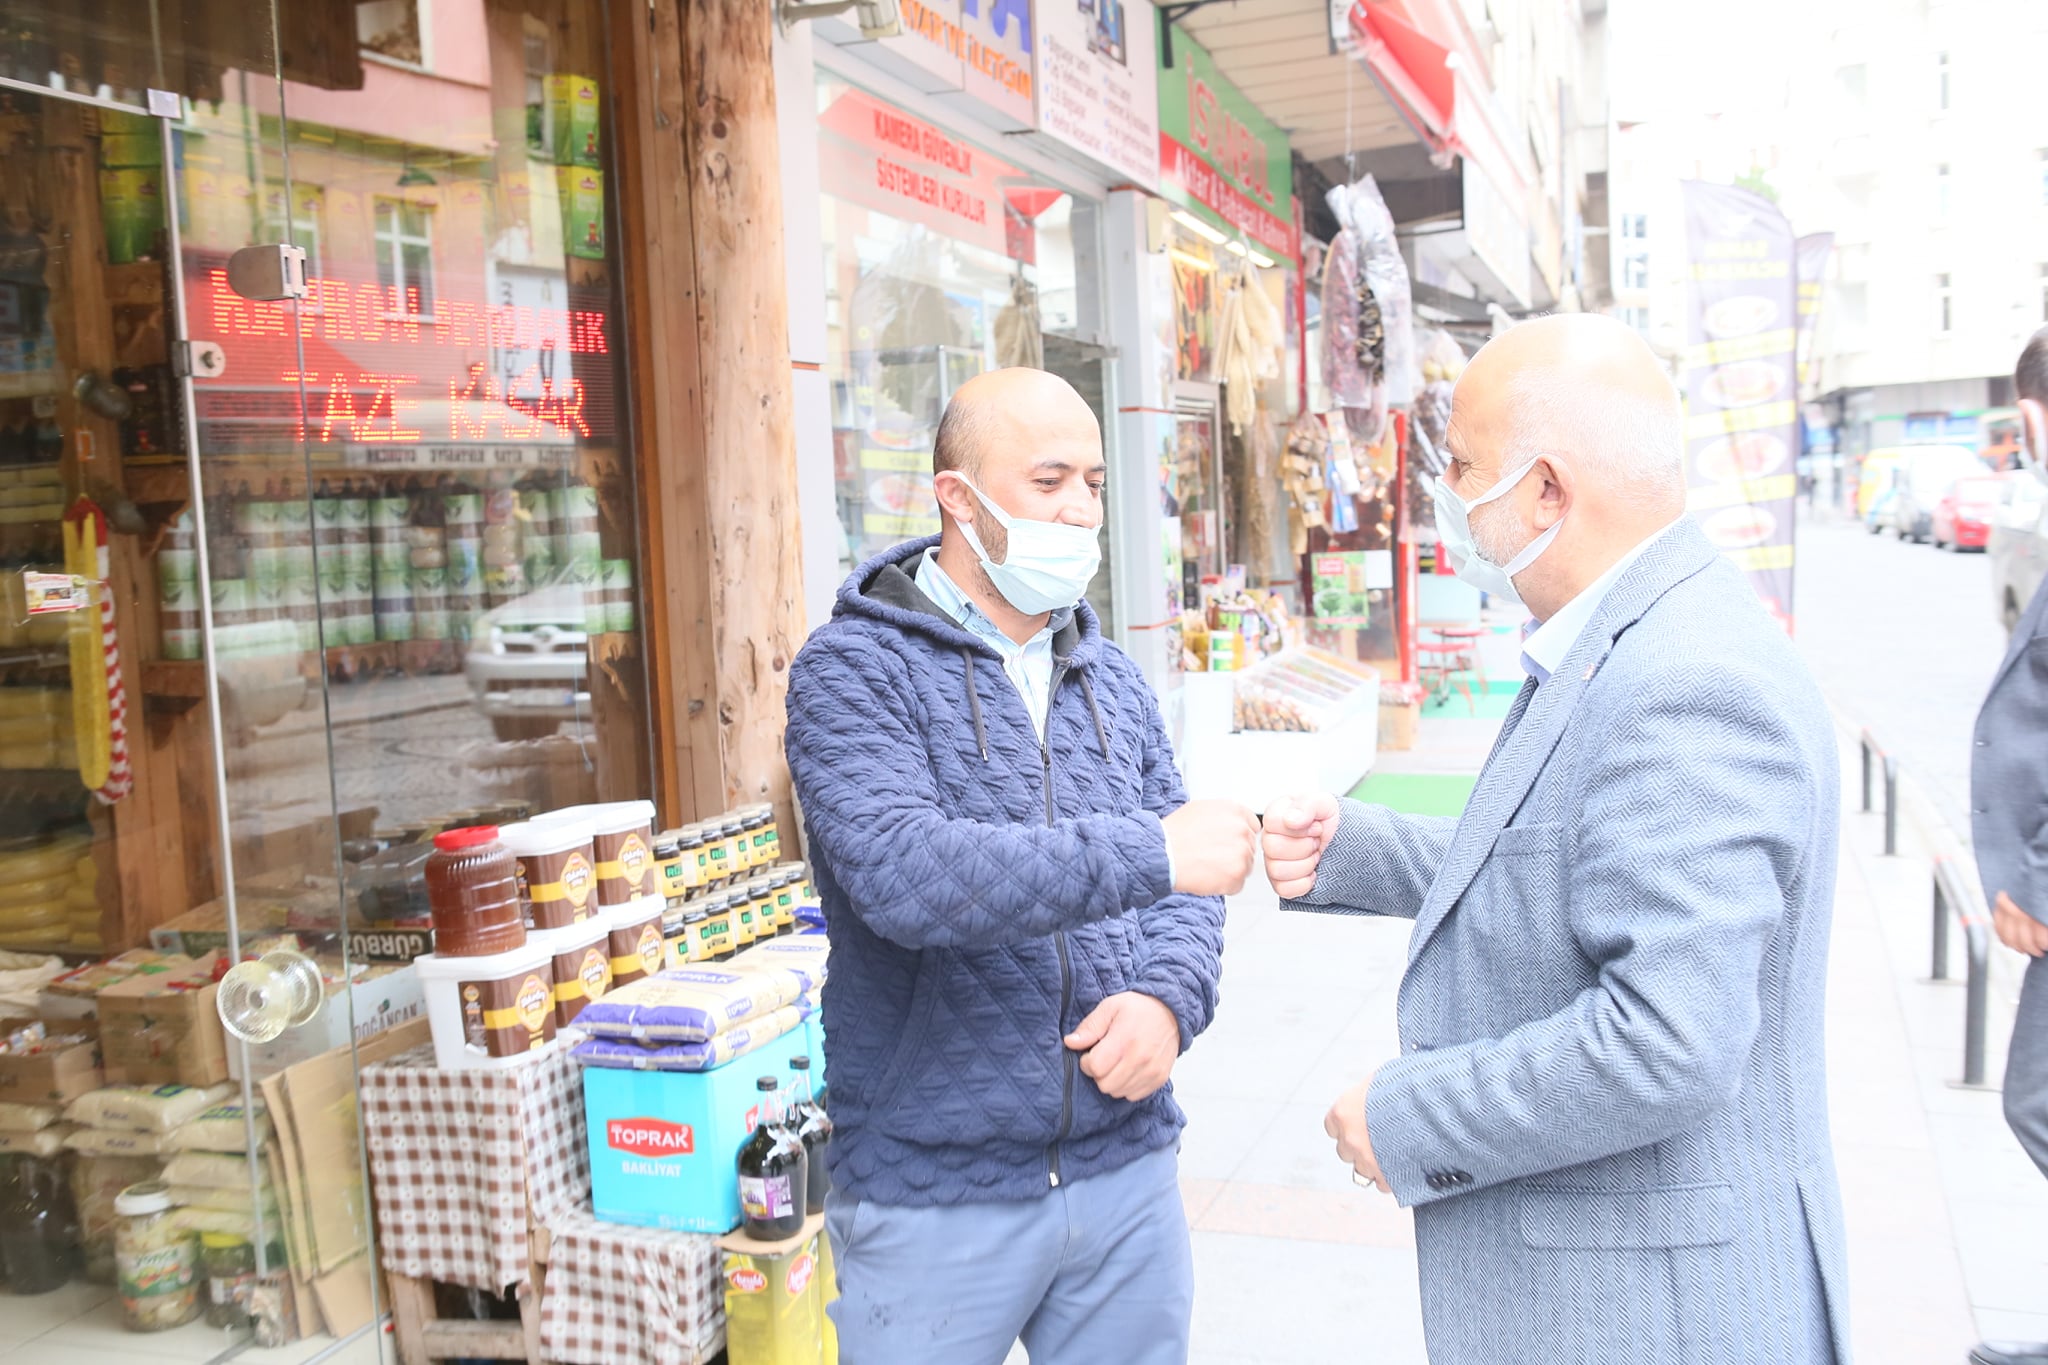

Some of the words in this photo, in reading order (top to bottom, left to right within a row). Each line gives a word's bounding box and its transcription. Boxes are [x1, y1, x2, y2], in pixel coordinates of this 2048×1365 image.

[944, 20, 966, 62] VE
[874, 109, 921, 155] KAMERA
[922, 126, 973, 178] GÜVENLİK
[876, 152, 940, 208] SİSTEMLERİ
[942, 184, 985, 224] KURULUR
[281, 371, 420, 443] TAZE
[611, 1125, 689, 1149] TOPRAK
[622, 1160, 682, 1178] BAKLİYAT
